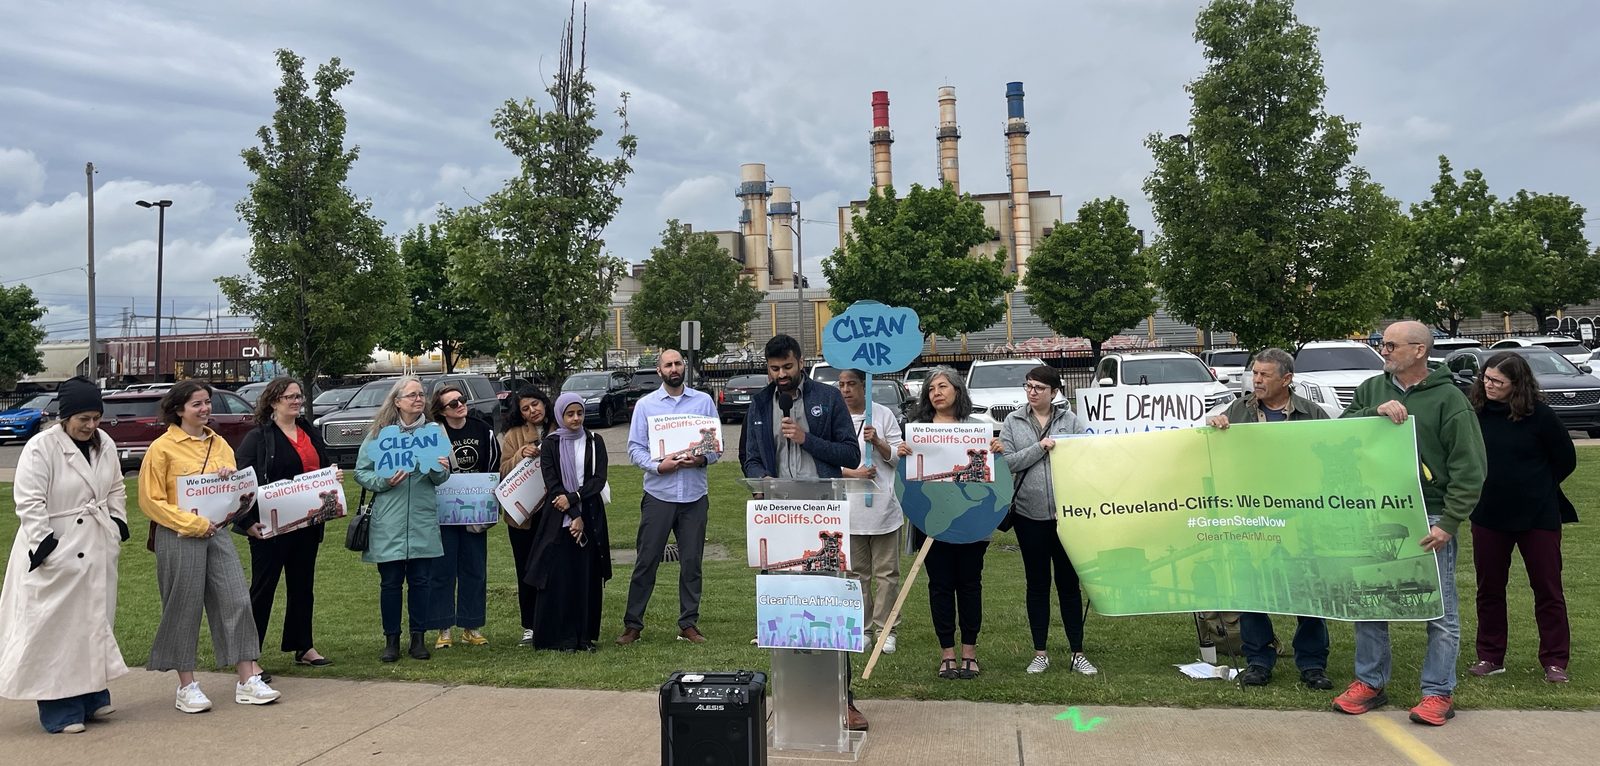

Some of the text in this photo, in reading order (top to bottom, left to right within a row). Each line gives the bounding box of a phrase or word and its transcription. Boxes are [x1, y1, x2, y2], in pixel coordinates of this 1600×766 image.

[832, 314, 906, 342] CLEAN
[242, 347, 264, 357] CN
[852, 342, 892, 366] AIR
[1084, 394, 1204, 422] WE DEMAND
[654, 420, 714, 431] CallCliffs.Com
[380, 433, 438, 450] CLEAN
[912, 434, 986, 444] CallCliffs.Com
[378, 451, 414, 470] AIR
[302, 473, 320, 482] Clean
[320, 470, 332, 478] Air!
[502, 461, 541, 498] CallCliffs.C
[506, 466, 525, 484] Deserve
[186, 481, 255, 497] CallCliffs.Com
[264, 479, 334, 500] CallCliffs.Com
[802, 504, 826, 512] Clean
[1062, 494, 1414, 519] Hey, Cleveland-Cliffs: We Demand Clean Air!
[754, 514, 841, 525] CallCliffs.Com
[1188, 516, 1286, 528] #GreenSteelNow
[1196, 532, 1282, 544] ClearTheAirMI.org
[759, 595, 862, 610] ClearTheAirMI.org
